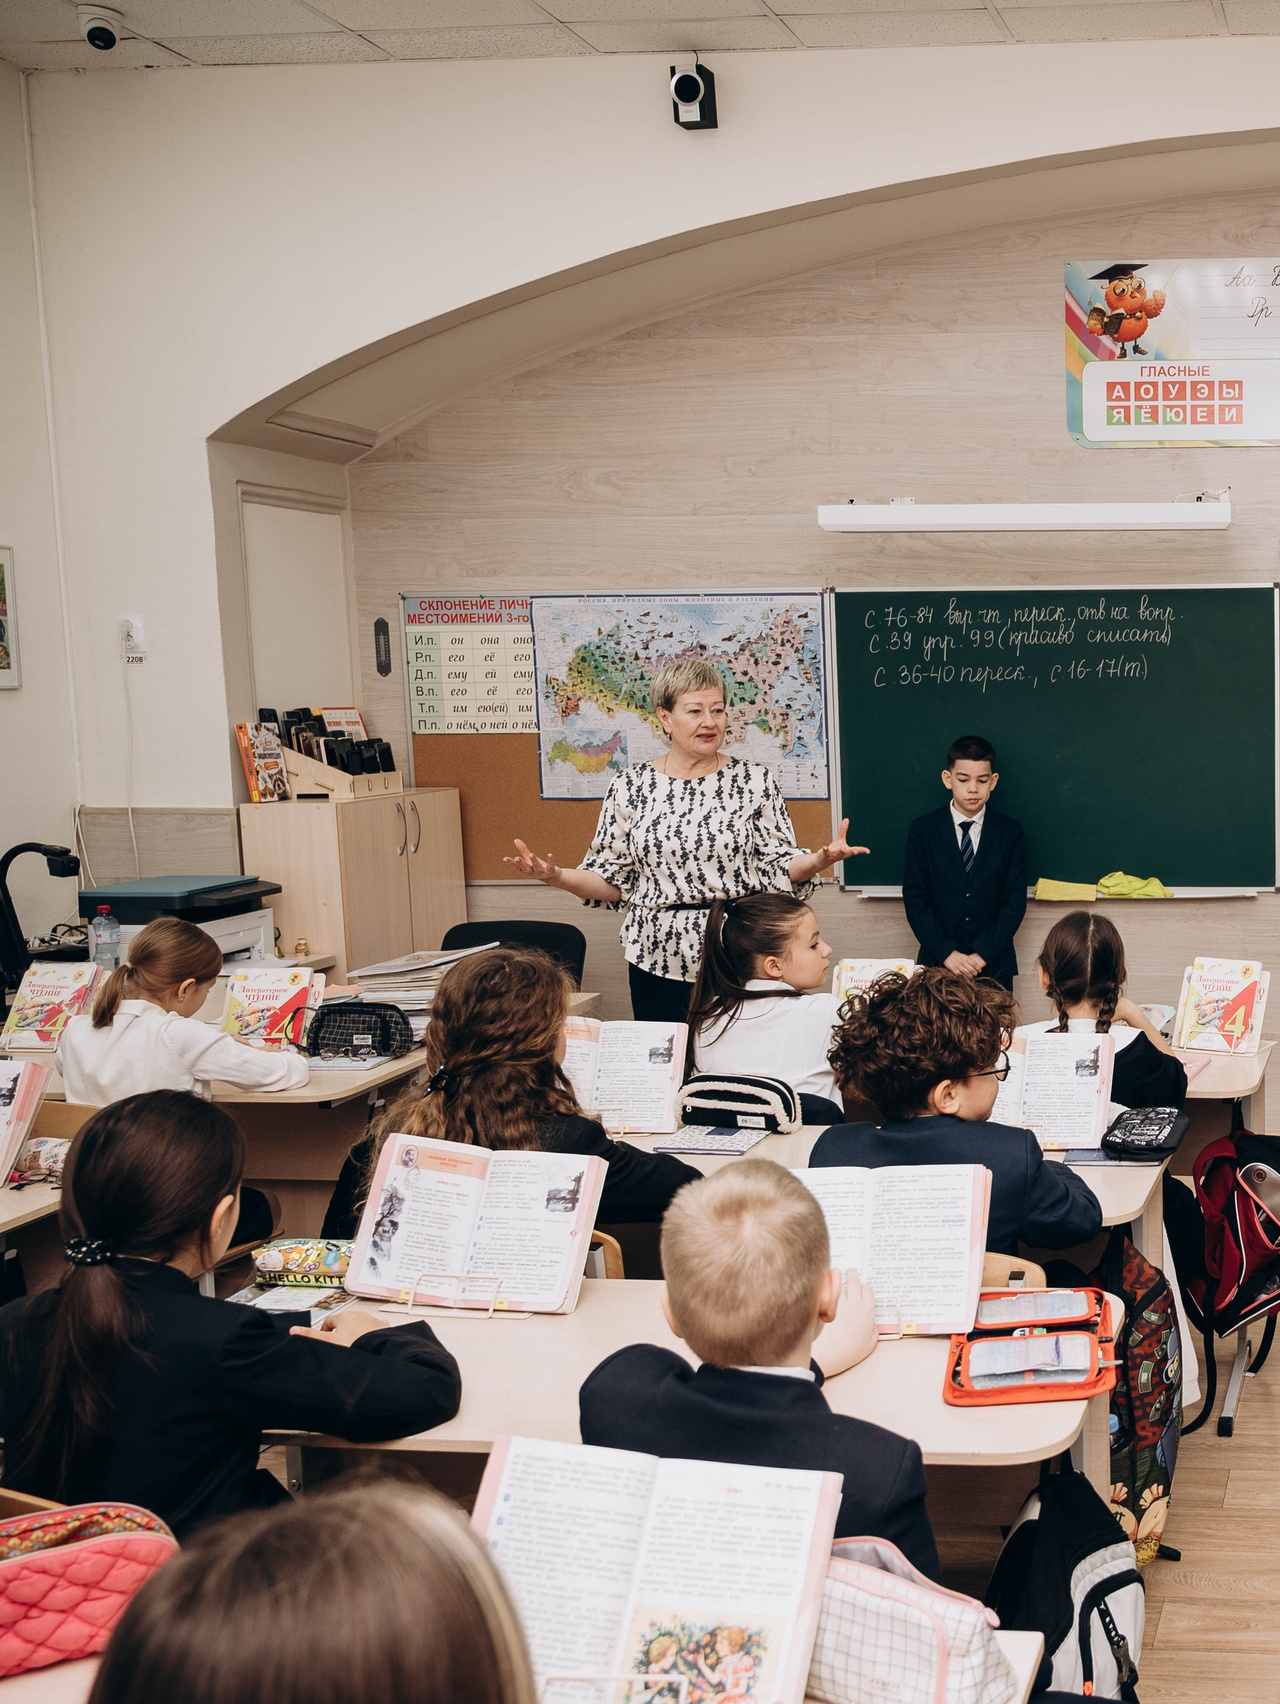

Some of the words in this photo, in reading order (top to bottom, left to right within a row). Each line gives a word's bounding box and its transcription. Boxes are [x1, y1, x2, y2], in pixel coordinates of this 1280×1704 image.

[1247, 297, 1272, 326] Рр
[1140, 365, 1210, 378] ГЛАСНЫЕ
[420, 600, 495, 611] СКЛОНЕНИЕ
[408, 611, 503, 623] МЕСТОИМЕНИЙ
[507, 613, 529, 623] 3-го
[1111, 606, 1130, 620] на
[415, 636, 437, 645] И.п.
[451, 637, 464, 645] он
[480, 637, 499, 645] она
[513, 636, 532, 645] оно
[1087, 624, 1172, 646] списать)
[415, 653, 435, 662] Р.п.
[448, 654, 464, 663] его
[485, 653, 495, 661] её
[514, 654, 530, 662] его
[415, 670, 437, 681] Д.п.
[448, 671, 467, 682] ему
[485, 670, 497, 679] ей
[514, 670, 533, 681] ему
[416, 687, 437, 696] В.п.
[451, 687, 467, 696] его
[487, 687, 497, 696] её
[516, 687, 532, 696] его
[418, 704, 438, 713] Т.п.
[453, 705, 467, 713] им
[478, 702, 508, 715] ею(ей)
[519, 704, 532, 712] им
[418, 720, 440, 730] П.п.
[456, 721, 476, 730] нём
[490, 721, 508, 729] ней
[24, 981, 70, 989] Литературное
[1196, 975, 1240, 985] Литературное
[238, 986, 288, 995] Литературное
[1202, 984, 1233, 992] ЧТЕНИЕ
[1224, 1005, 1245, 1038] 4
[271, 1012, 294, 1045] 4
